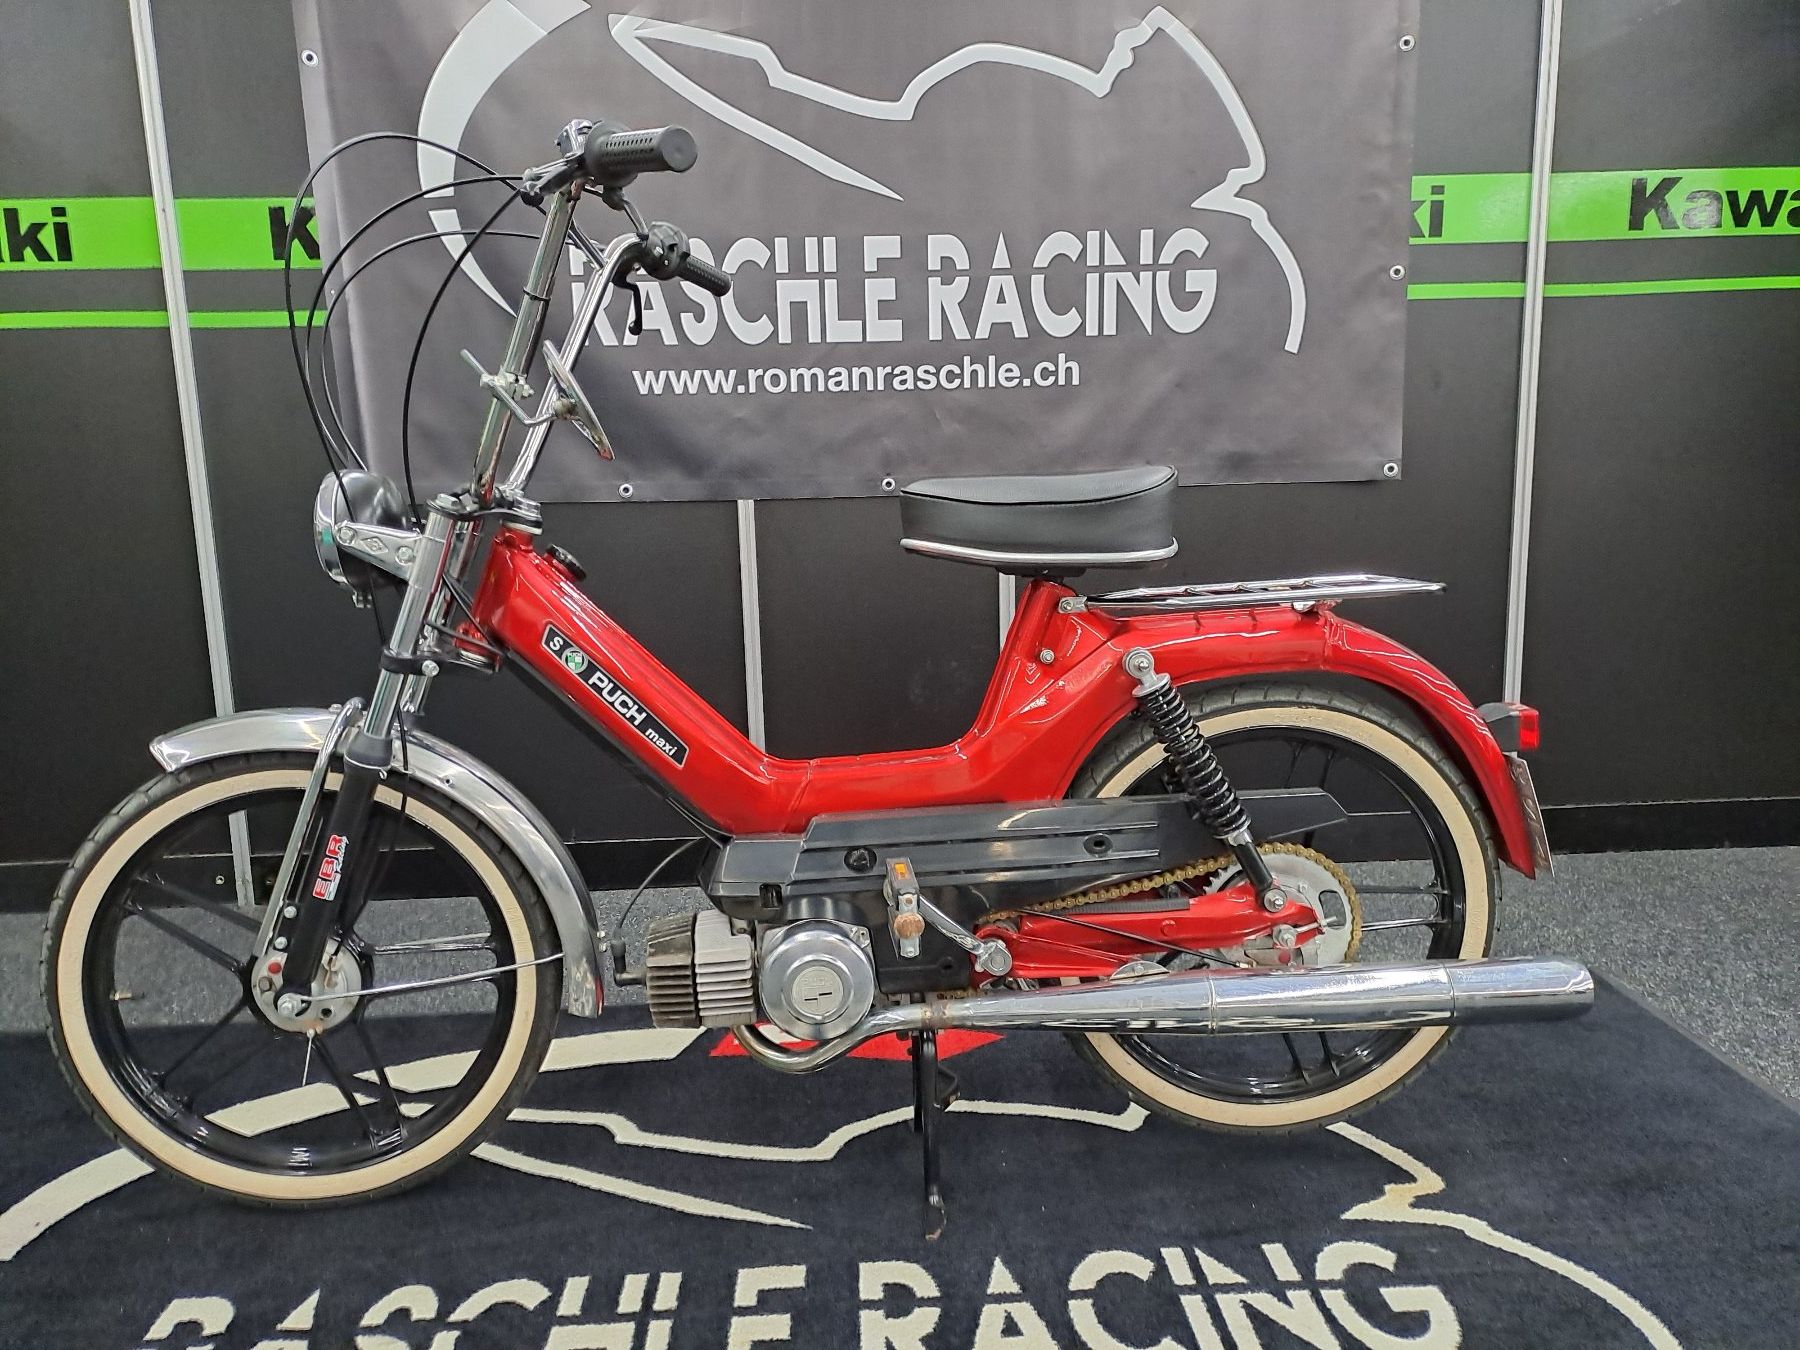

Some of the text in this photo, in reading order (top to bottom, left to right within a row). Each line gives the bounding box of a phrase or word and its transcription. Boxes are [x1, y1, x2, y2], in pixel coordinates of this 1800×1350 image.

[0, 206, 73, 262] ki
[569, 228, 1217, 347] RASCHLE RACING
[633, 353, 1081, 396] www.romanraschle.ch
[549, 636, 678, 757] S PUCH maxi
[313, 834, 344, 900] EBR
[859, 1241, 1463, 1350] RACING
